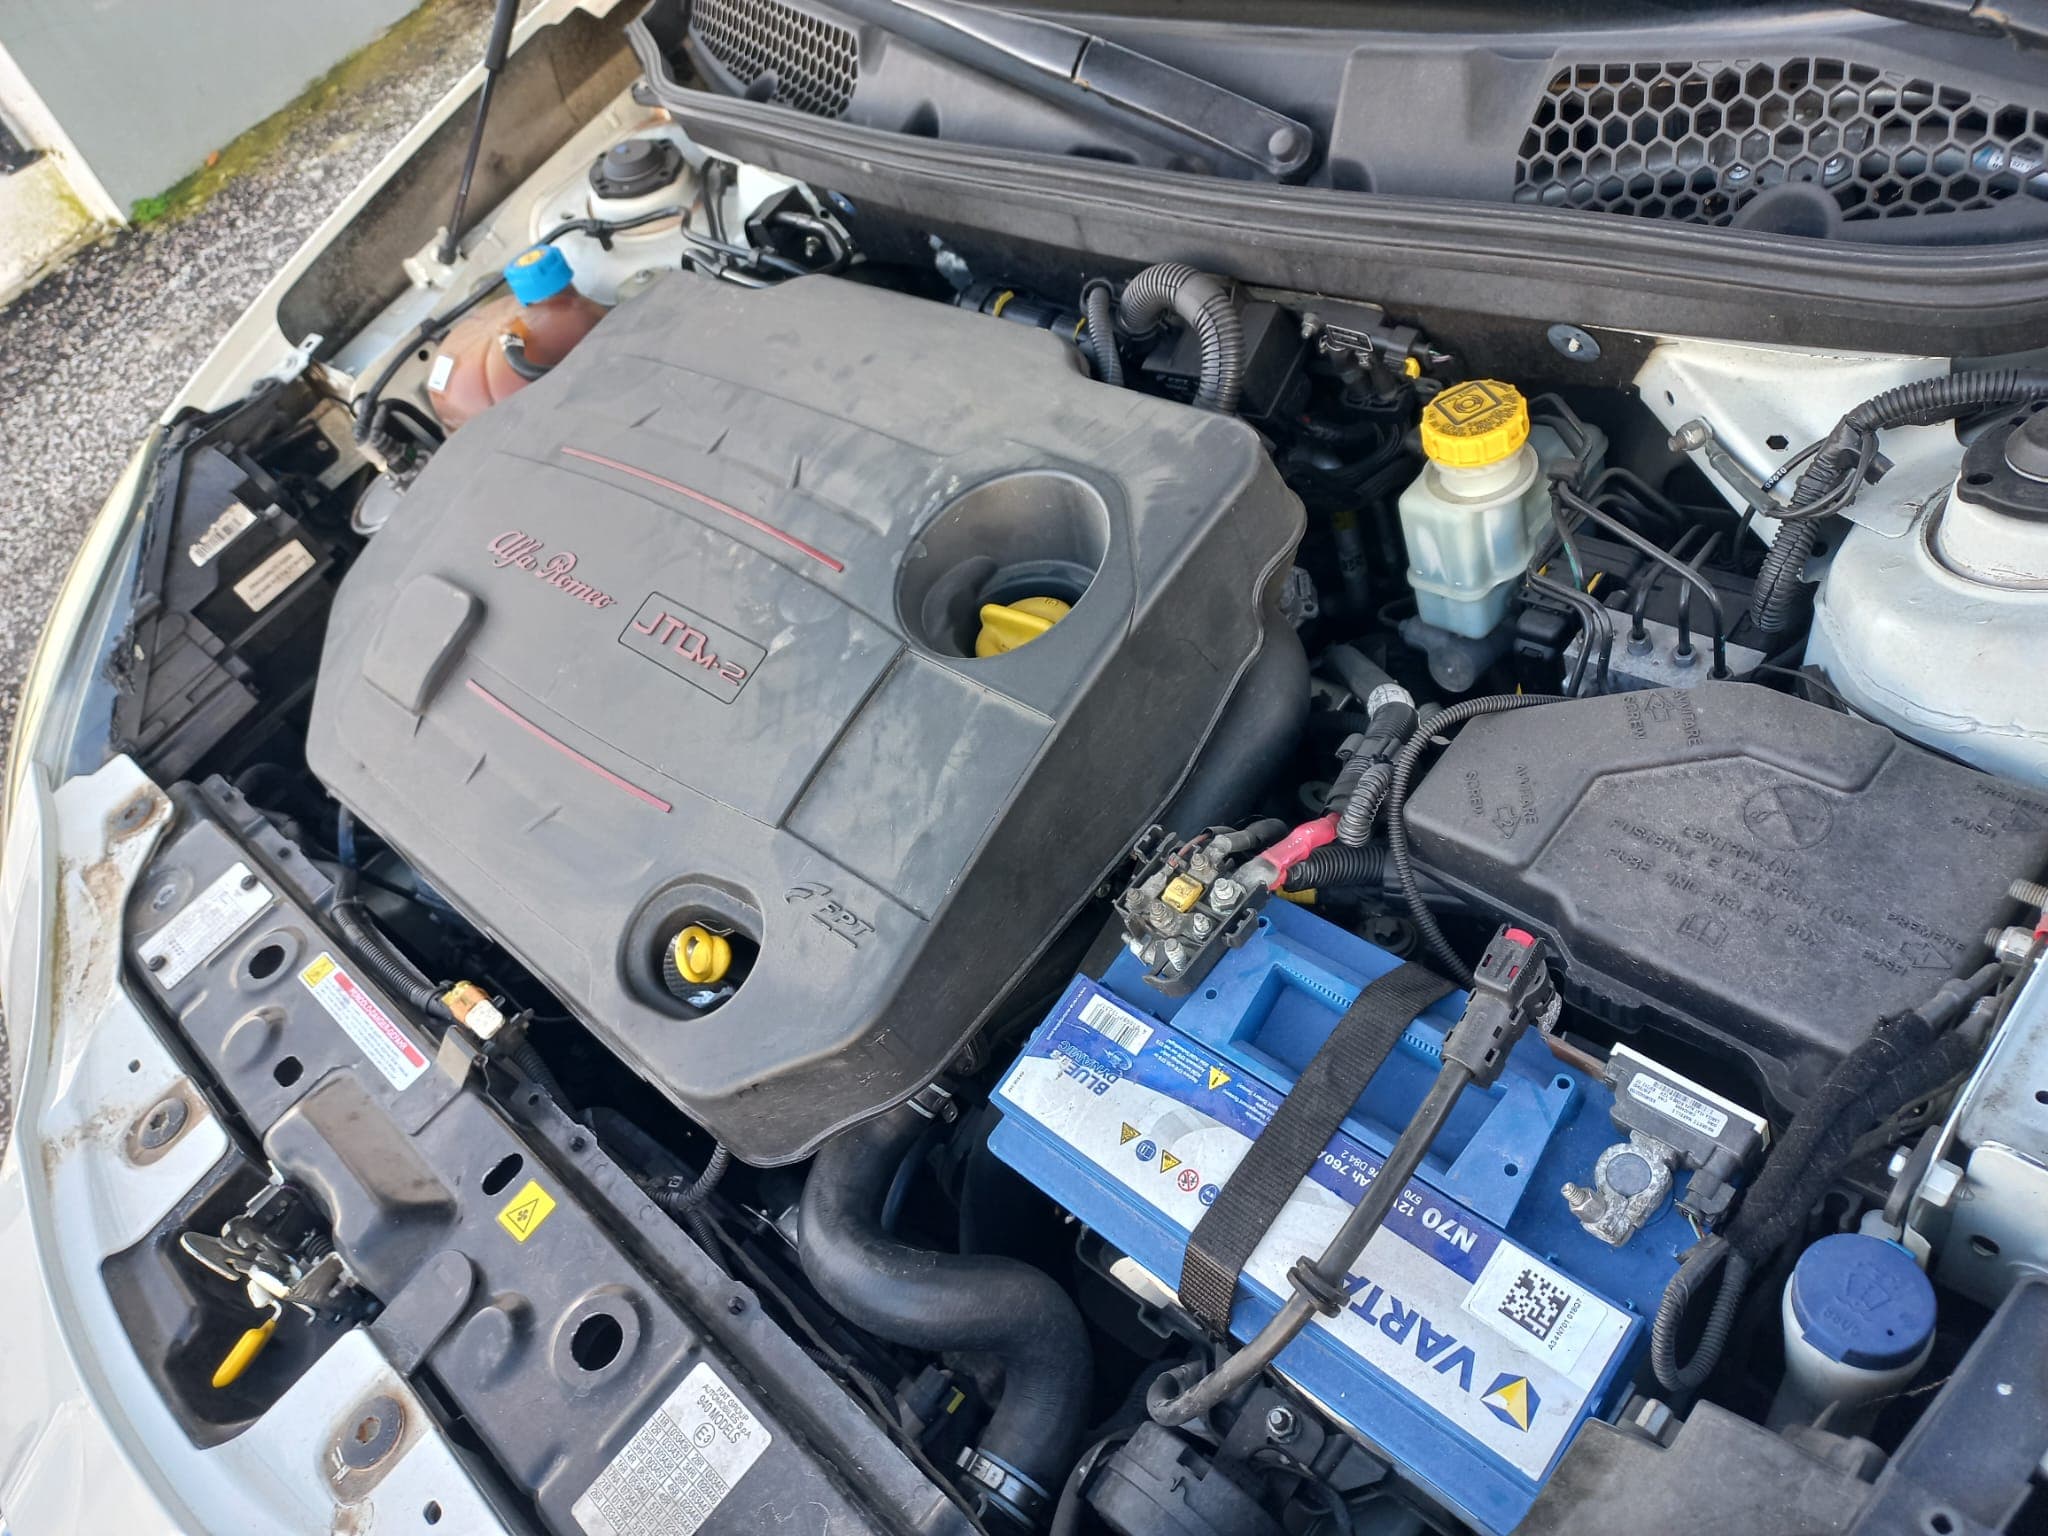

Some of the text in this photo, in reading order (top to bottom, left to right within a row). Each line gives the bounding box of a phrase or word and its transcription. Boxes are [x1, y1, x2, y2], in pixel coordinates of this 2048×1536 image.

[487, 530, 618, 609] Alfa Romeo
[1056, 1037, 1120, 1085] DYNAMIC
[1062, 1058, 1110, 1098] BLUE
[1347, 1152, 1369, 1171] D84
[1402, 1186, 1424, 1205] 570
[1417, 1204, 1479, 1254] N70
[1342, 1272, 1476, 1393] VARTA
[694, 1393, 742, 1445] 940 MODELS
[700, 1382, 741, 1425] AUTOMOBILES
[714, 1385, 751, 1423] FIAT GROUP
[647, 1421, 662, 1436] 12R
[655, 1412, 670, 1427] 11R
[691, 1453, 705, 1468] 28R
[623, 1449, 637, 1464] 14R
[643, 1456, 666, 1480] 003457
[597, 1478, 612, 1494] 21R
